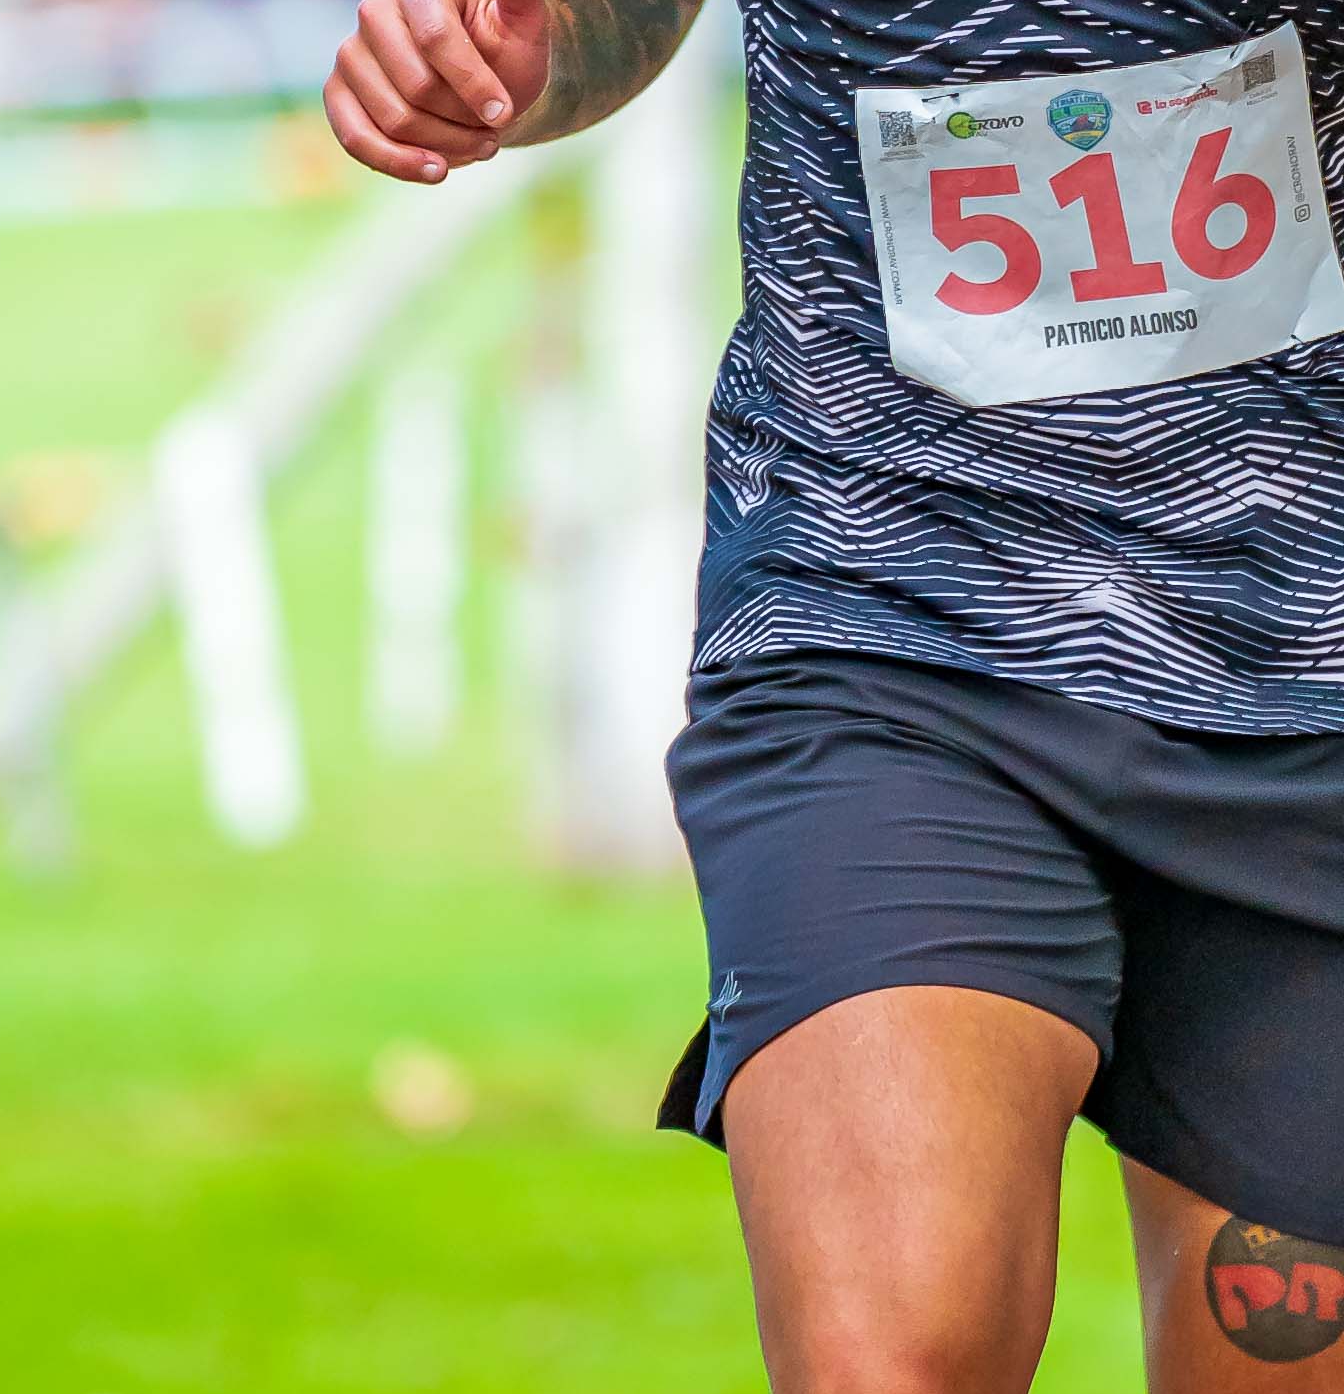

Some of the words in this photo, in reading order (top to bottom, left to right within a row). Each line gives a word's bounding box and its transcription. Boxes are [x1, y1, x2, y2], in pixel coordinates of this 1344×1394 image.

[1154, 99, 1167, 110] la
[1168, 88, 1218, 107] segunda
[929, 126, 1277, 316] 516
[1043, 316, 1125, 348] PATRICIO
[1130, 308, 1199, 338] ALONSO
